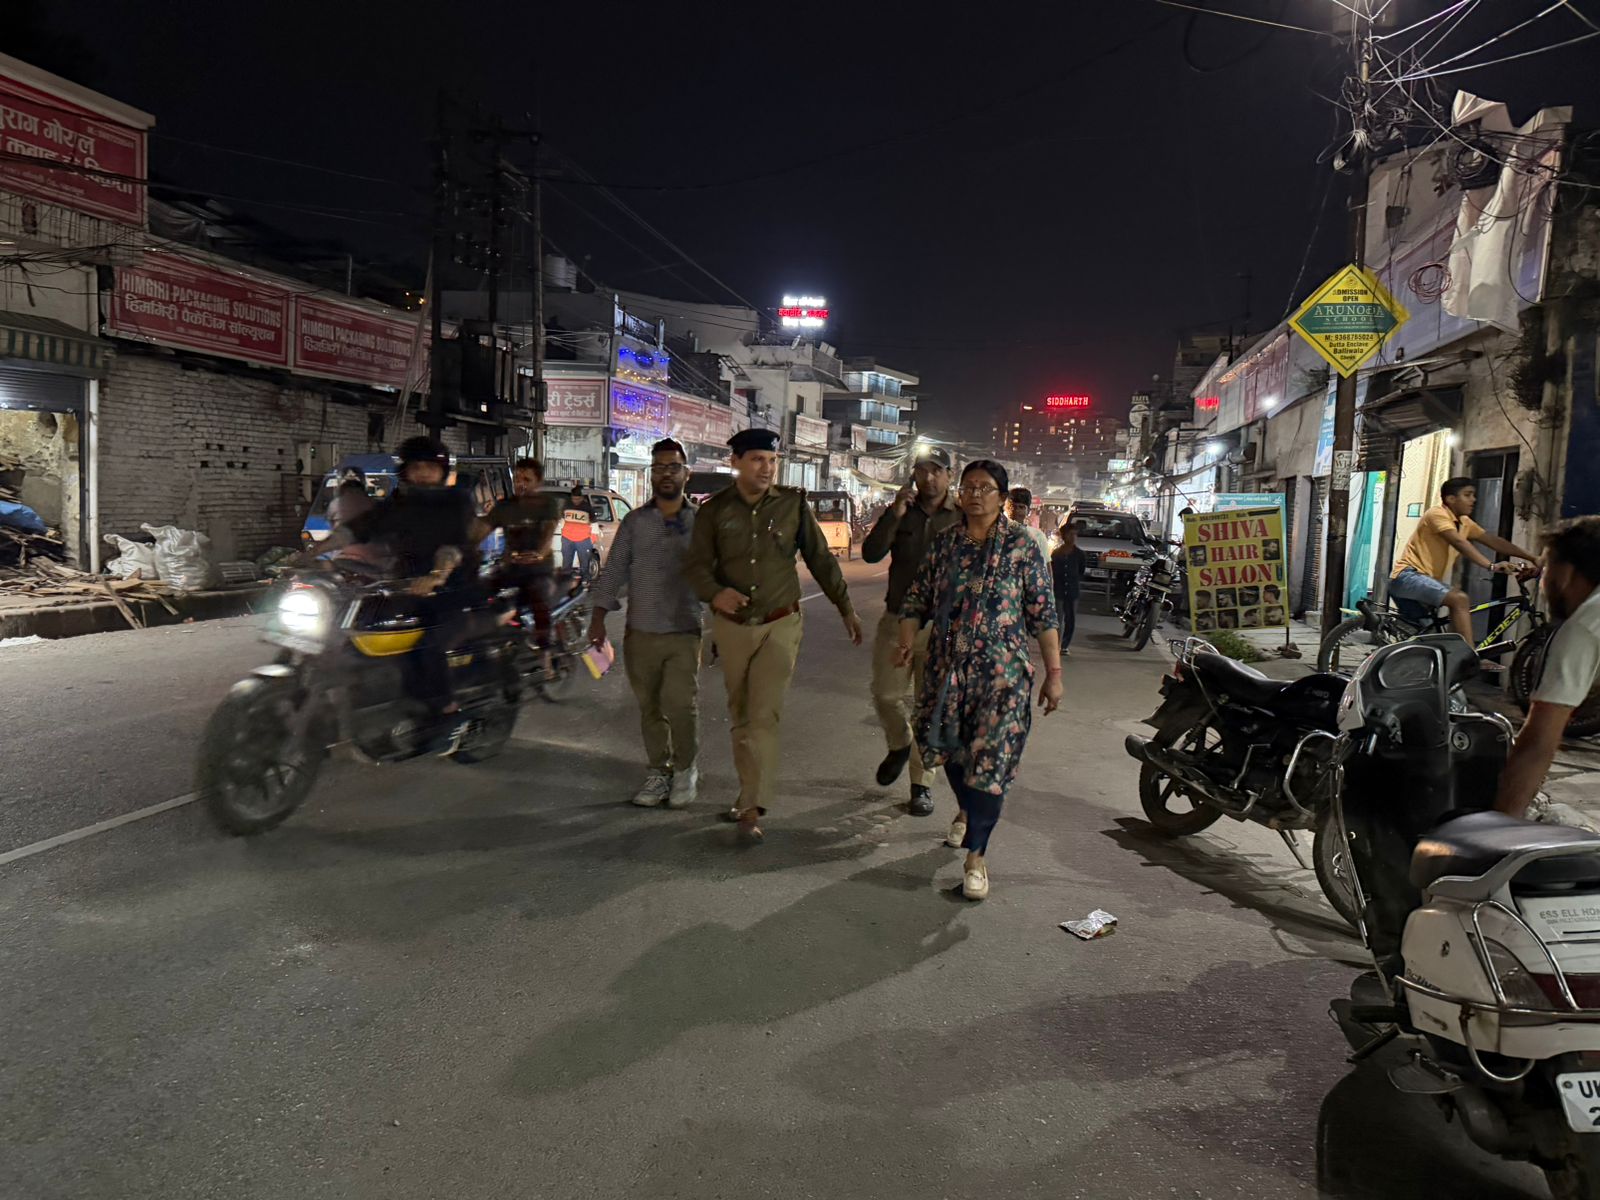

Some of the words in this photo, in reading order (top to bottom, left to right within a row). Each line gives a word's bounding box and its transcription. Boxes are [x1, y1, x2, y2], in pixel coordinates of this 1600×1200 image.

[122, 272, 169, 302] HIMGIRI
[173, 286, 230, 316] PACKAGING
[233, 301, 281, 328] SOLUTIONS
[302, 318, 334, 341] HIMGIRI
[335, 326, 375, 349] PACKAGING
[376, 335, 411, 357] SOLUTIONS
[1046, 396, 1089, 406] SIDDHARTH
[565, 511, 585, 521] FILA
[1198, 518, 1269, 542] SHIVA
[1211, 543, 1260, 562] HAIR
[1199, 563, 1272, 587] SALON
[1539, 909, 1559, 920] ESS
[1561, 907, 1580, 918] ELL
